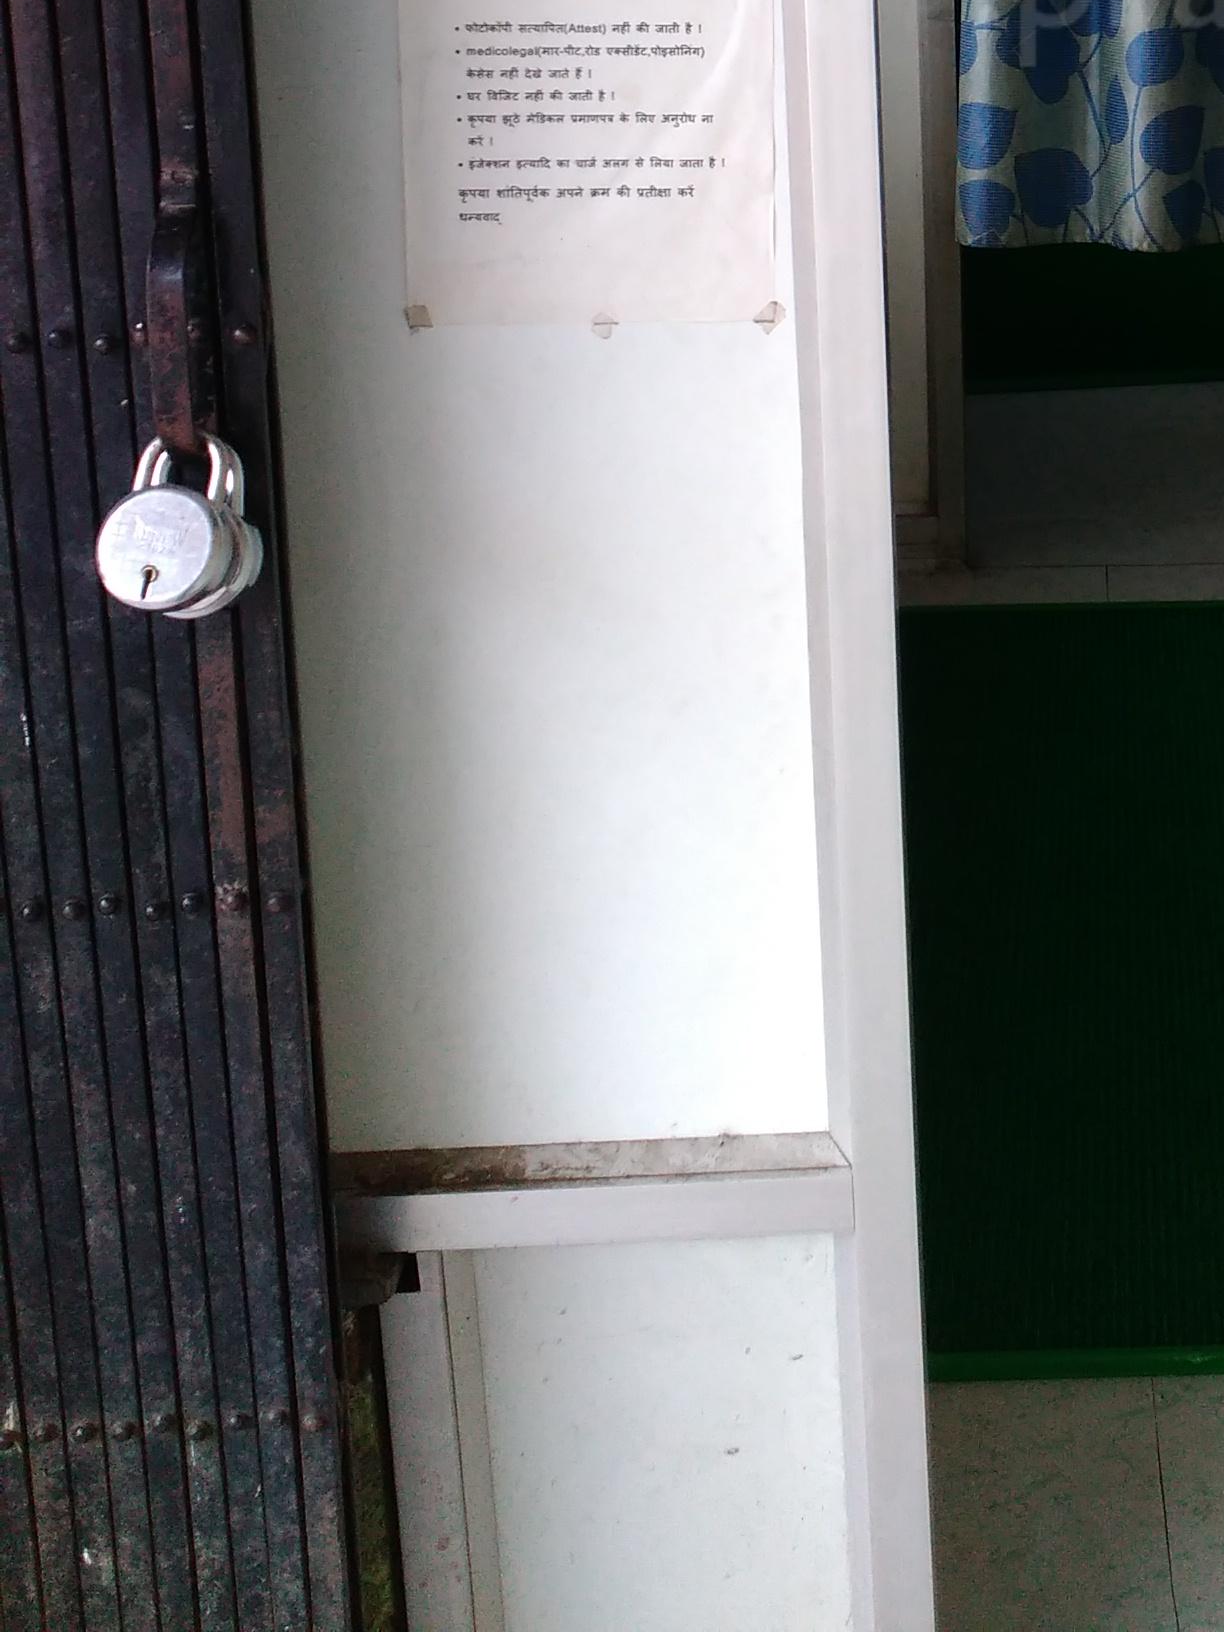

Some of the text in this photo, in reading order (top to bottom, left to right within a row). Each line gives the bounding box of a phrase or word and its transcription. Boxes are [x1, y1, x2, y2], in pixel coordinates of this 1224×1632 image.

[636, 21, 650, 34] की
[655, 21, 680, 34] जाती
[548, 68, 570, 80] जाते
[467, 91, 481, 102] घर
[487, 89, 519, 102] विजिट
[549, 89, 563, 102] की
[568, 89, 593, 101] जाती
[467, 114, 496, 128] कृपया
[619, 113, 630, 124] के
[635, 111, 656, 124] लिए
[661, 112, 697, 128] अनुरोध
[701, 113, 714, 124] ना
[556, 159, 570, 168] का
[602, 158, 630, 168] अलग
[635, 156, 645, 168] से
[649, 156, 674, 168] लिया
[679, 158, 704, 168] जाता
[458, 188, 490, 203] कृपया
[496, 185, 550, 202] शांतिपूर्वक
[556, 186, 584, 199] अपने
[590, 188, 611, 199] क्रम
[616, 185, 632, 198] की
[636, 185, 672, 198] प्रतीक्षा
